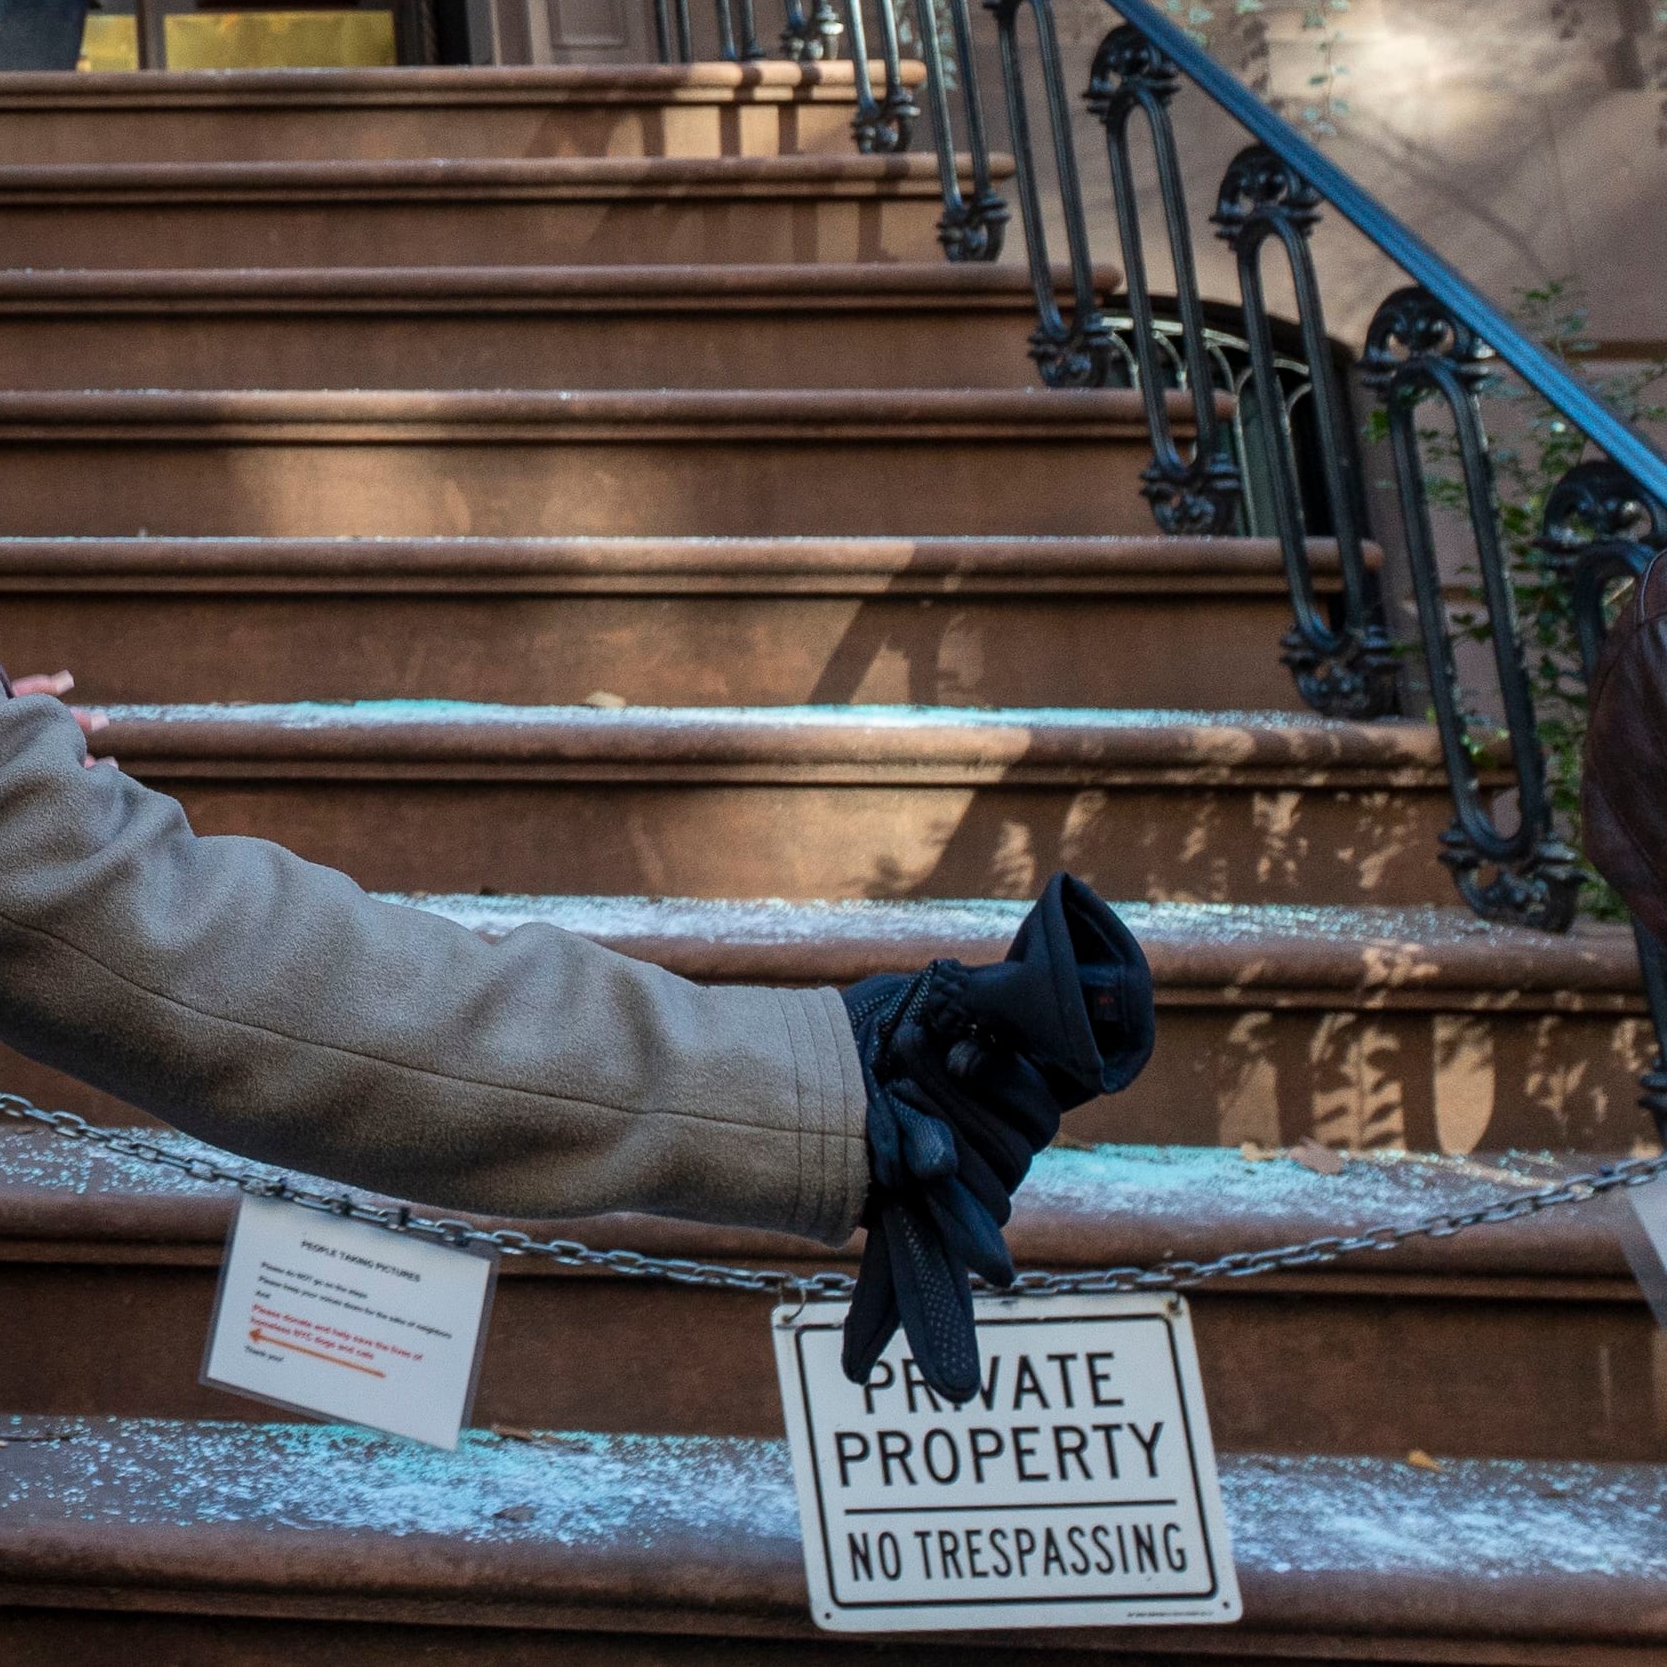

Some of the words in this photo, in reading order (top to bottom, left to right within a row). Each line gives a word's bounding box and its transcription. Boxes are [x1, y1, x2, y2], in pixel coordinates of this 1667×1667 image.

[301, 1240, 336, 1256] PEOPLE
[340, 1252, 373, 1267] TAKING
[375, 1262, 420, 1282] PICTURES
[253, 1303, 280, 1317] Please
[863, 1352, 1125, 1414] PRVATE
[834, 1421, 1165, 1488] PROPERTY
[847, 1528, 902, 1581] NO
[915, 1523, 1186, 1579] TRESPASSING
